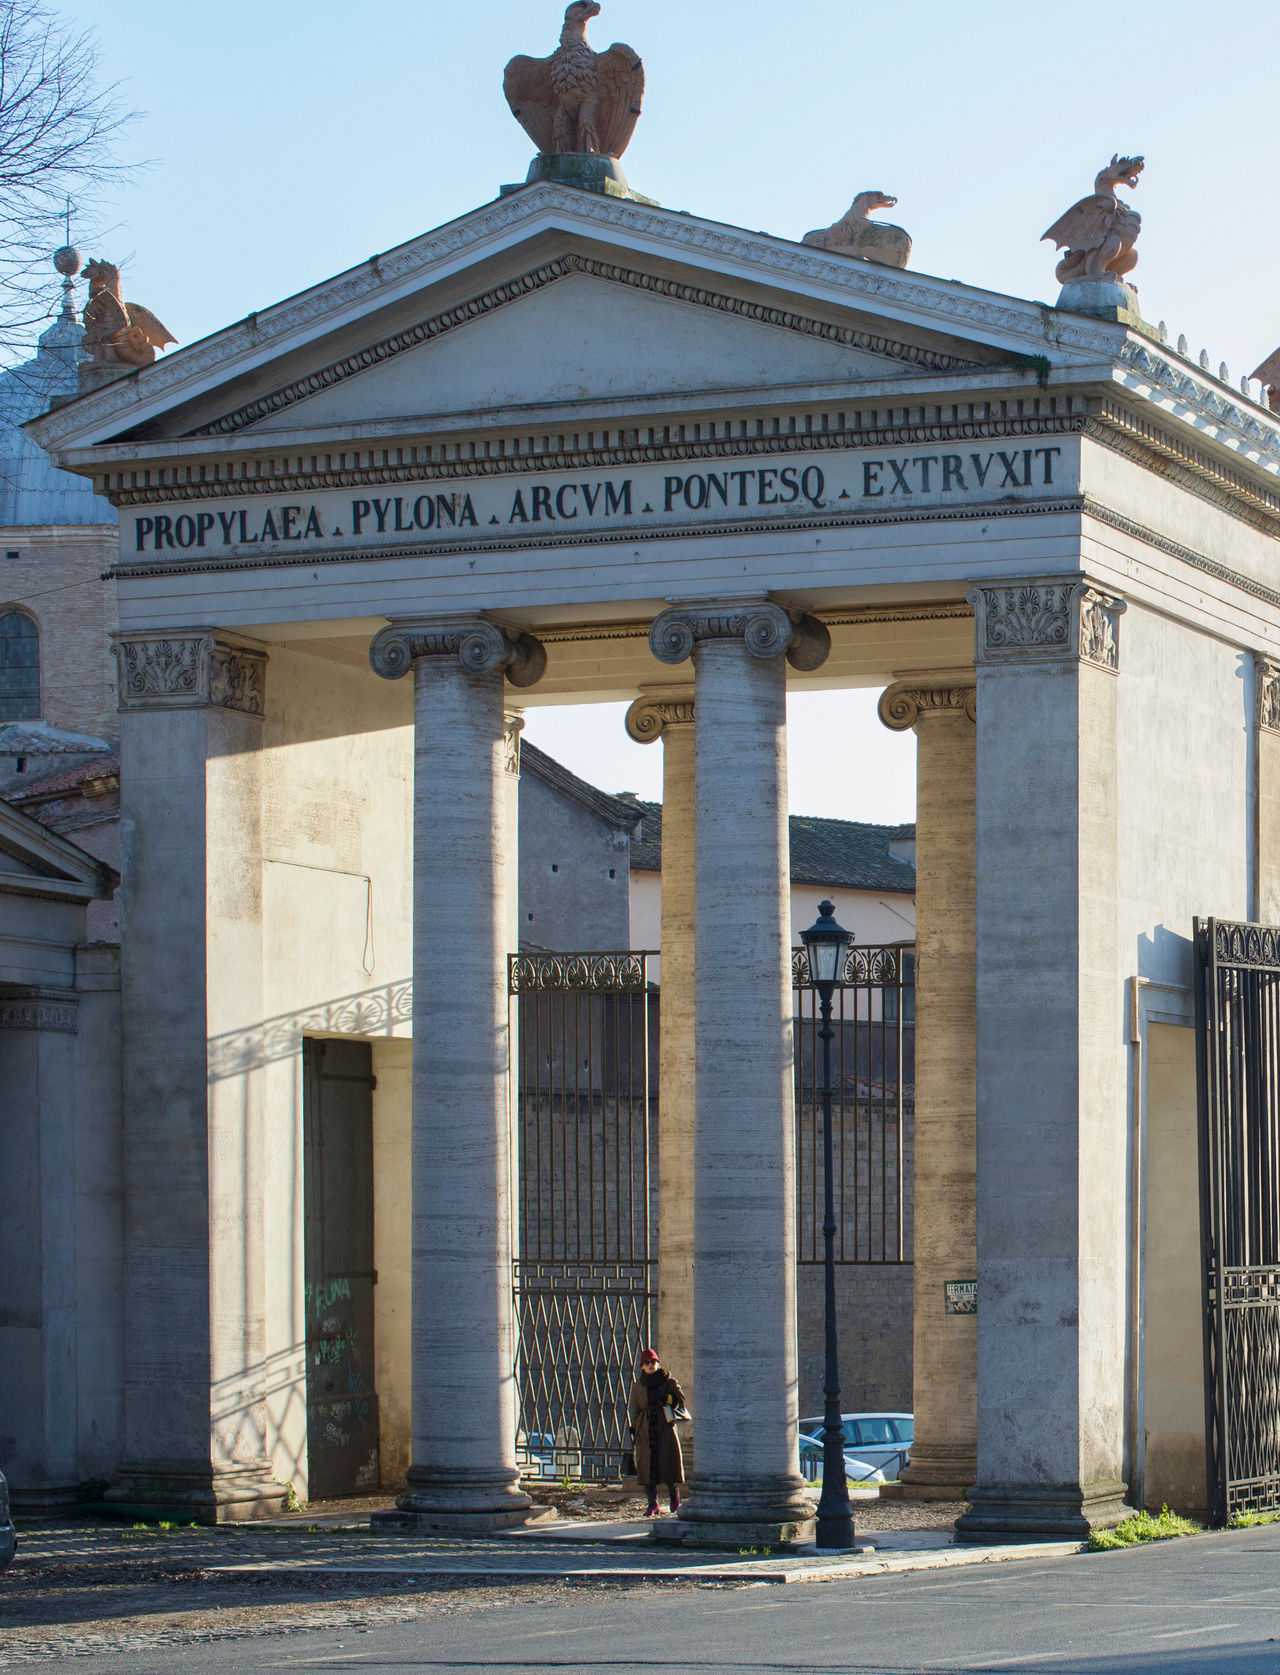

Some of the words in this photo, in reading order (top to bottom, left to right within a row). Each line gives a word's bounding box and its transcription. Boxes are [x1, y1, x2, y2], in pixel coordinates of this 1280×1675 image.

[135, 505, 322, 552] PROPYLAEA
[351, 492, 478, 535] PYLONA
[508, 480, 632, 523] ARCVM
[664, 465, 826, 512] PONTESQ
[862, 446, 1061, 498] EXTRVXIT
[947, 1284, 977, 1295] FERMATA
